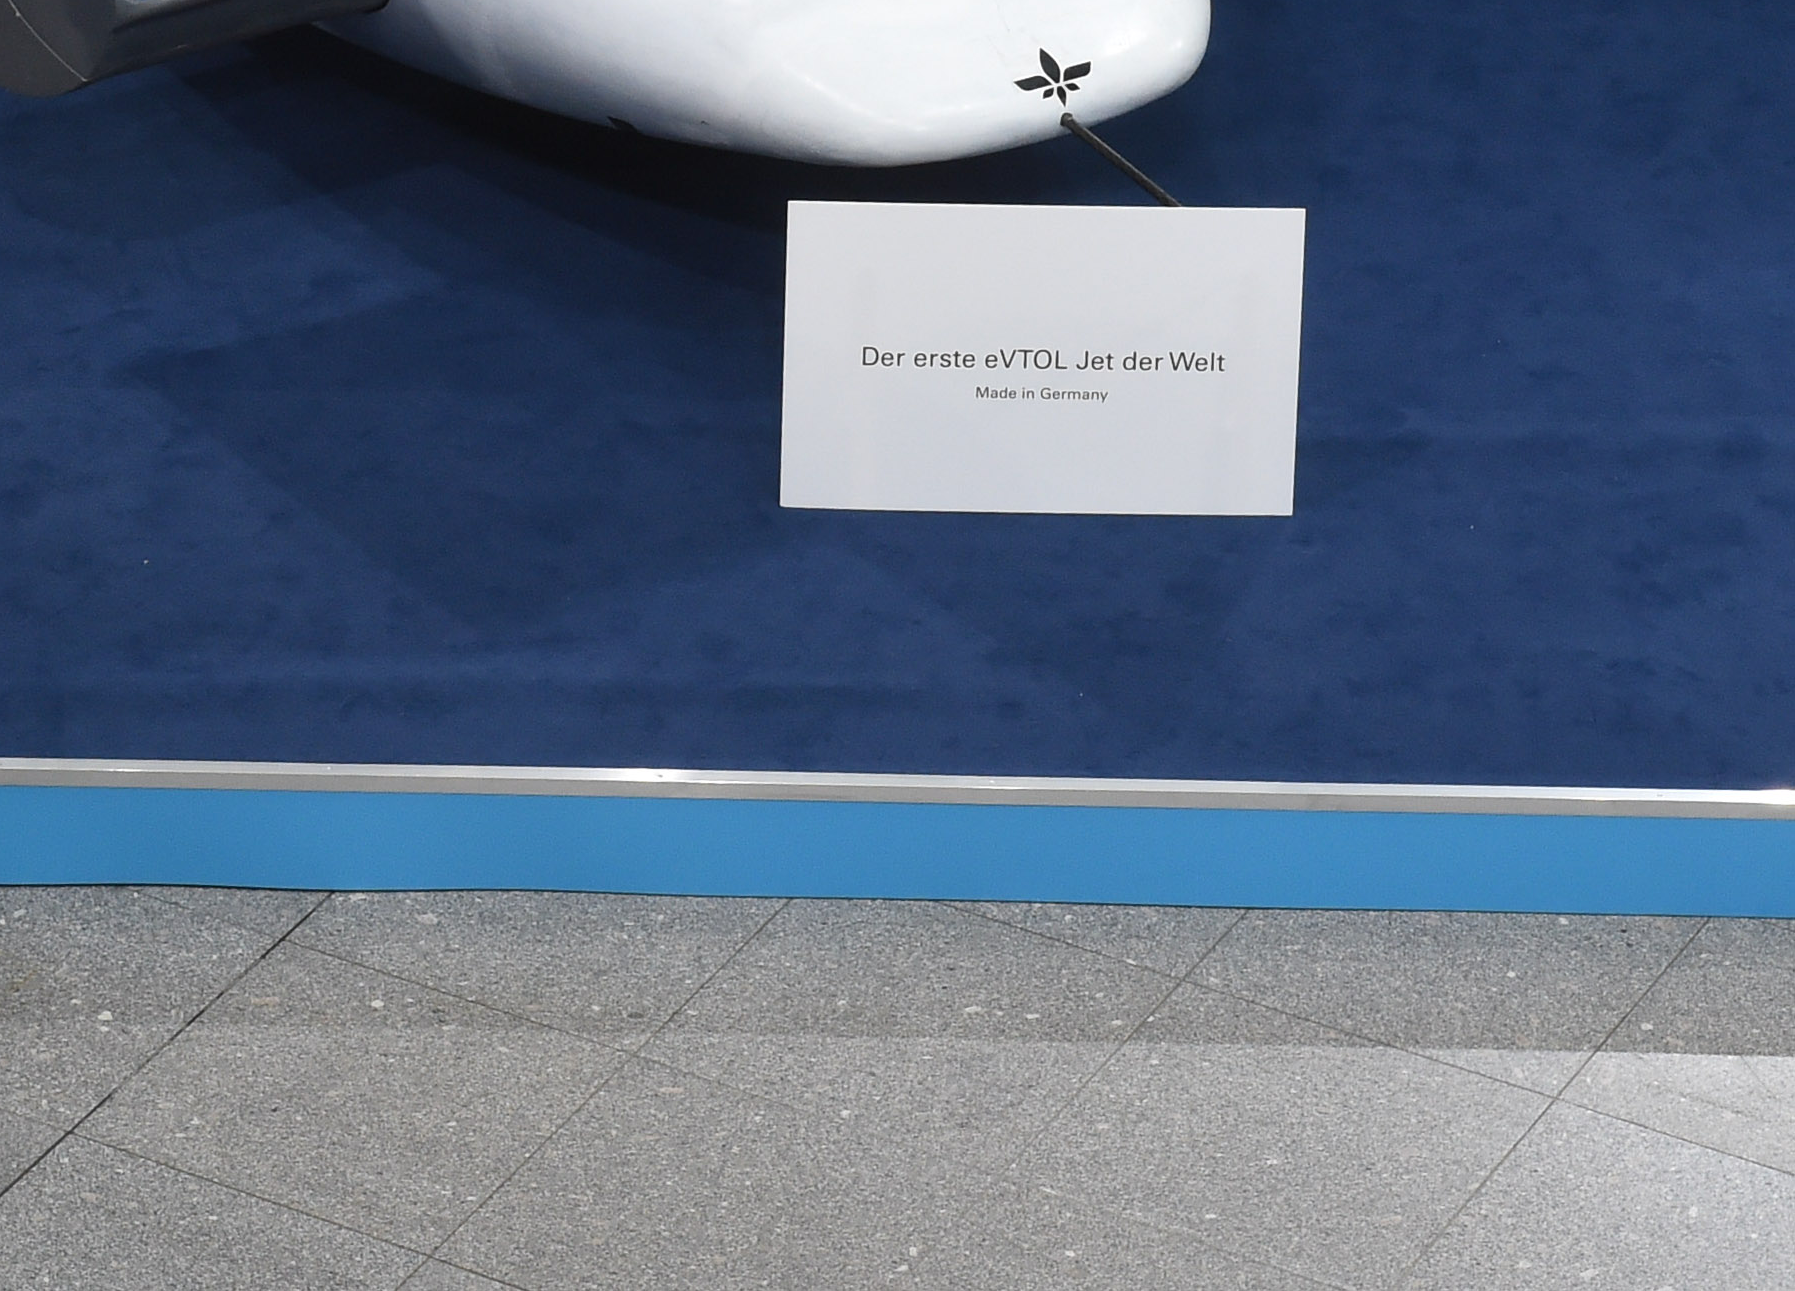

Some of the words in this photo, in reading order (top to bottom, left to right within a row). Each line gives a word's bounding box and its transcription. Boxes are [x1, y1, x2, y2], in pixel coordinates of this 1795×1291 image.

[861, 346, 906, 367] Der
[913, 350, 976, 369] erste
[984, 348, 1068, 370] eVTOL
[1075, 350, 1114, 371] Jet
[1122, 351, 1164, 371] der
[1169, 351, 1225, 372] Welt
[975, 386, 1017, 399] Made
[1021, 387, 1035, 399] in
[1040, 387, 1109, 403] Germany
